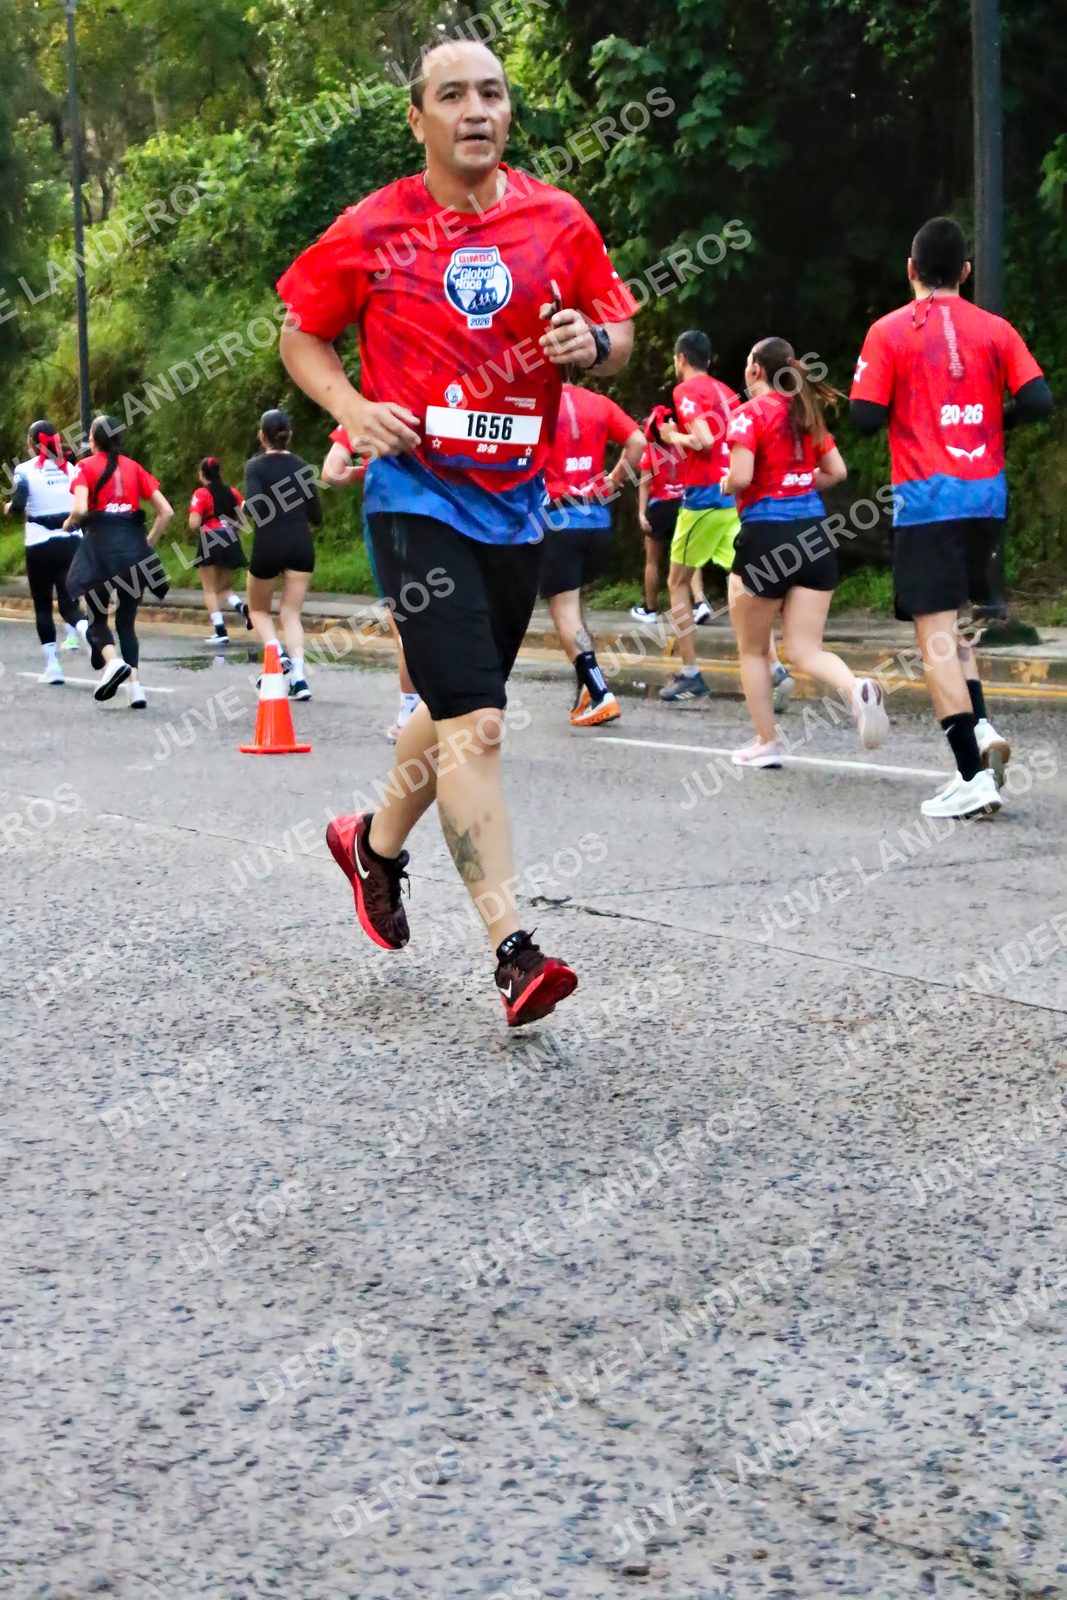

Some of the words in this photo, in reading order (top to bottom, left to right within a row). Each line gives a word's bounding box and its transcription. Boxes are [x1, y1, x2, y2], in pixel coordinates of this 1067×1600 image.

[458, 254, 494, 263] BIMBO
[460, 266, 495, 280] Global
[455, 279, 482, 290] Race
[470, 317, 490, 326] 2026
[941, 403, 983, 426] 20-26
[467, 413, 514, 441] 1656
